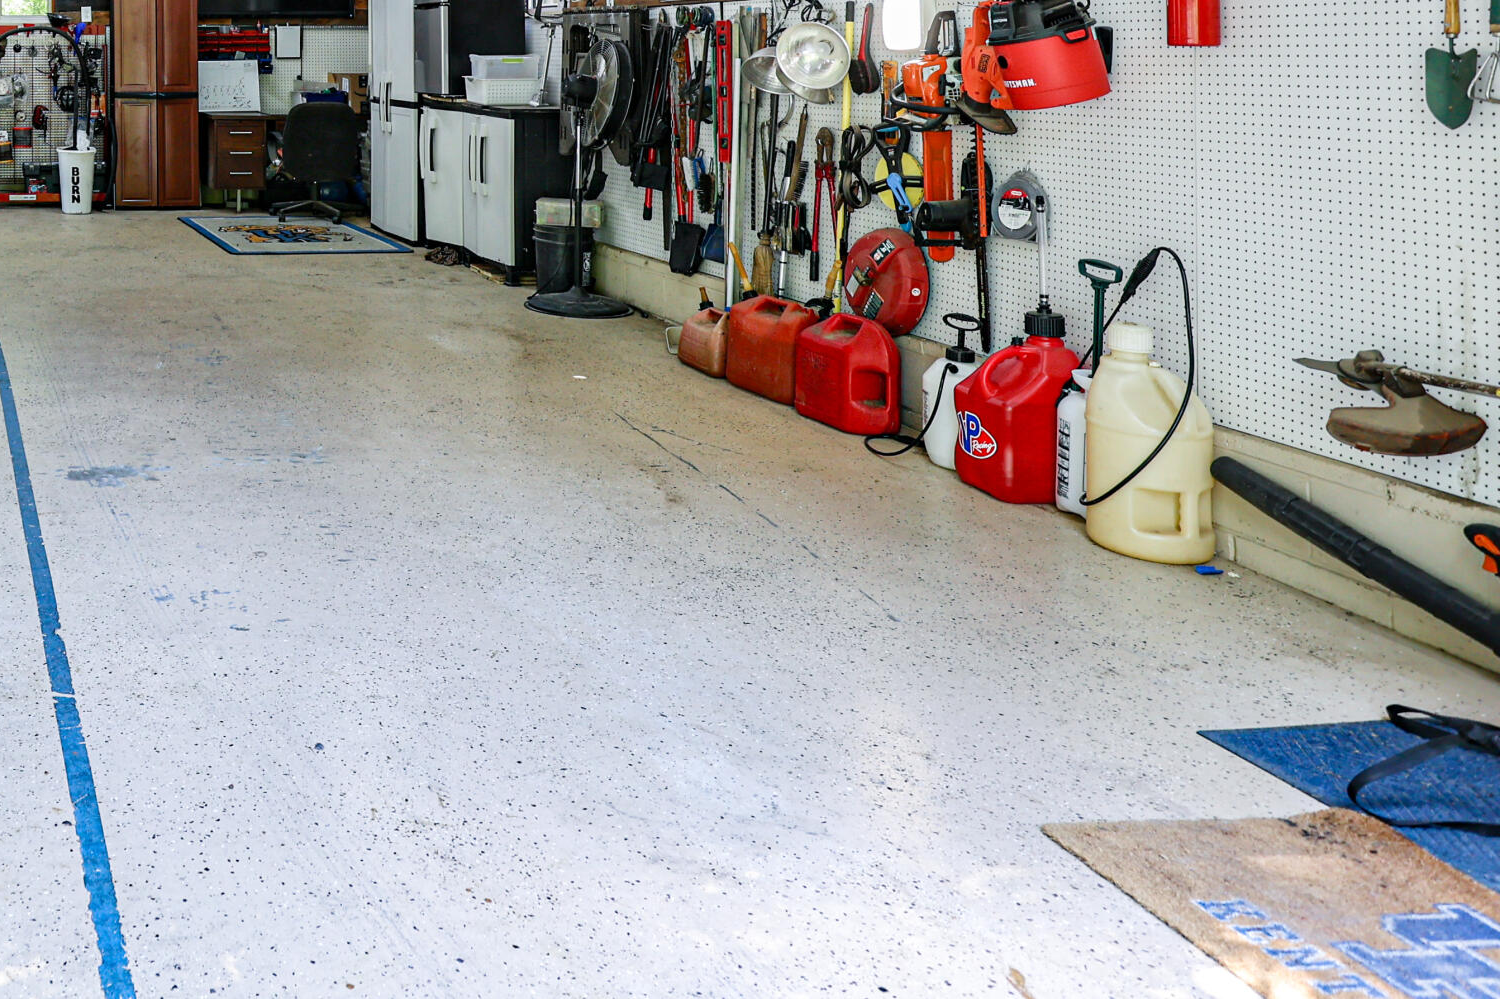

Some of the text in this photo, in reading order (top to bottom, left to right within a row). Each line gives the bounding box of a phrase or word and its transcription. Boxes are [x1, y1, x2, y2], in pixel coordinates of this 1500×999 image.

[71, 166, 81, 204] BURN
[957, 411, 981, 455] VP
[972, 440, 996, 453] Racing
